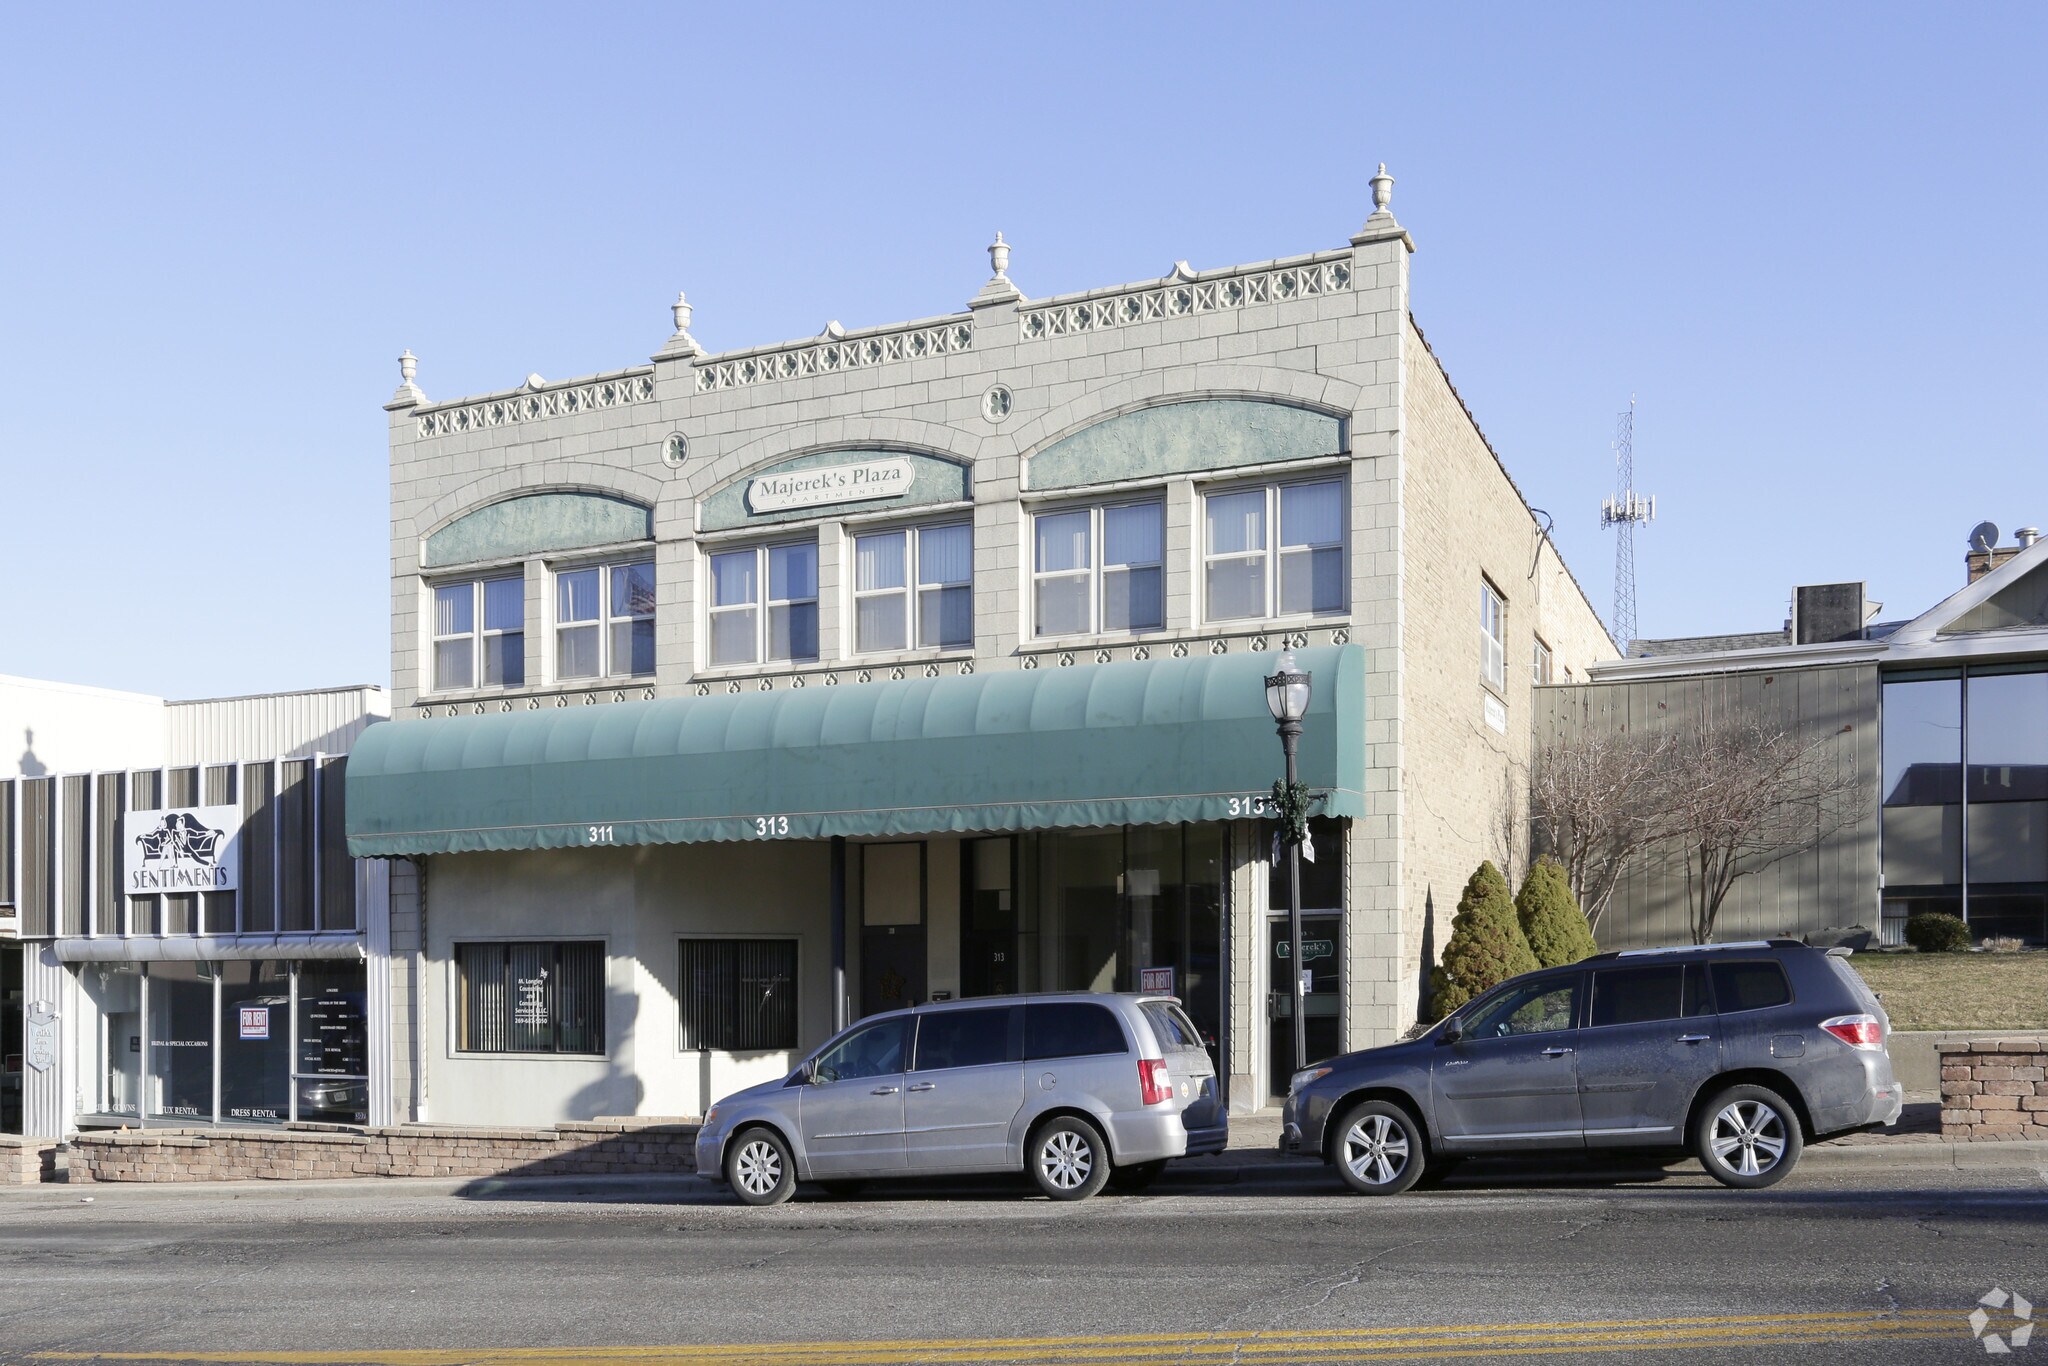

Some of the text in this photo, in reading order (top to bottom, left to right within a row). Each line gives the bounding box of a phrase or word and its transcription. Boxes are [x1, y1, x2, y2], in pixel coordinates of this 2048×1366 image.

[760, 464, 901, 497] Majerek's Plaza
[780, 486, 885, 505] APARTMENTS
[588, 826, 613, 843] 311
[756, 816, 789, 836] 313
[132, 867, 227, 889] SENTIMENTS
[1284, 943, 1326, 951] Merek's
[994, 952, 1005, 962] 313
[1143, 972, 1170, 990] FOR RENT
[242, 1011, 266, 1026] FOR RENT
[160, 1106, 199, 1116] TUX RENTAL
[231, 1108, 277, 1118] DRESS RENTAL
